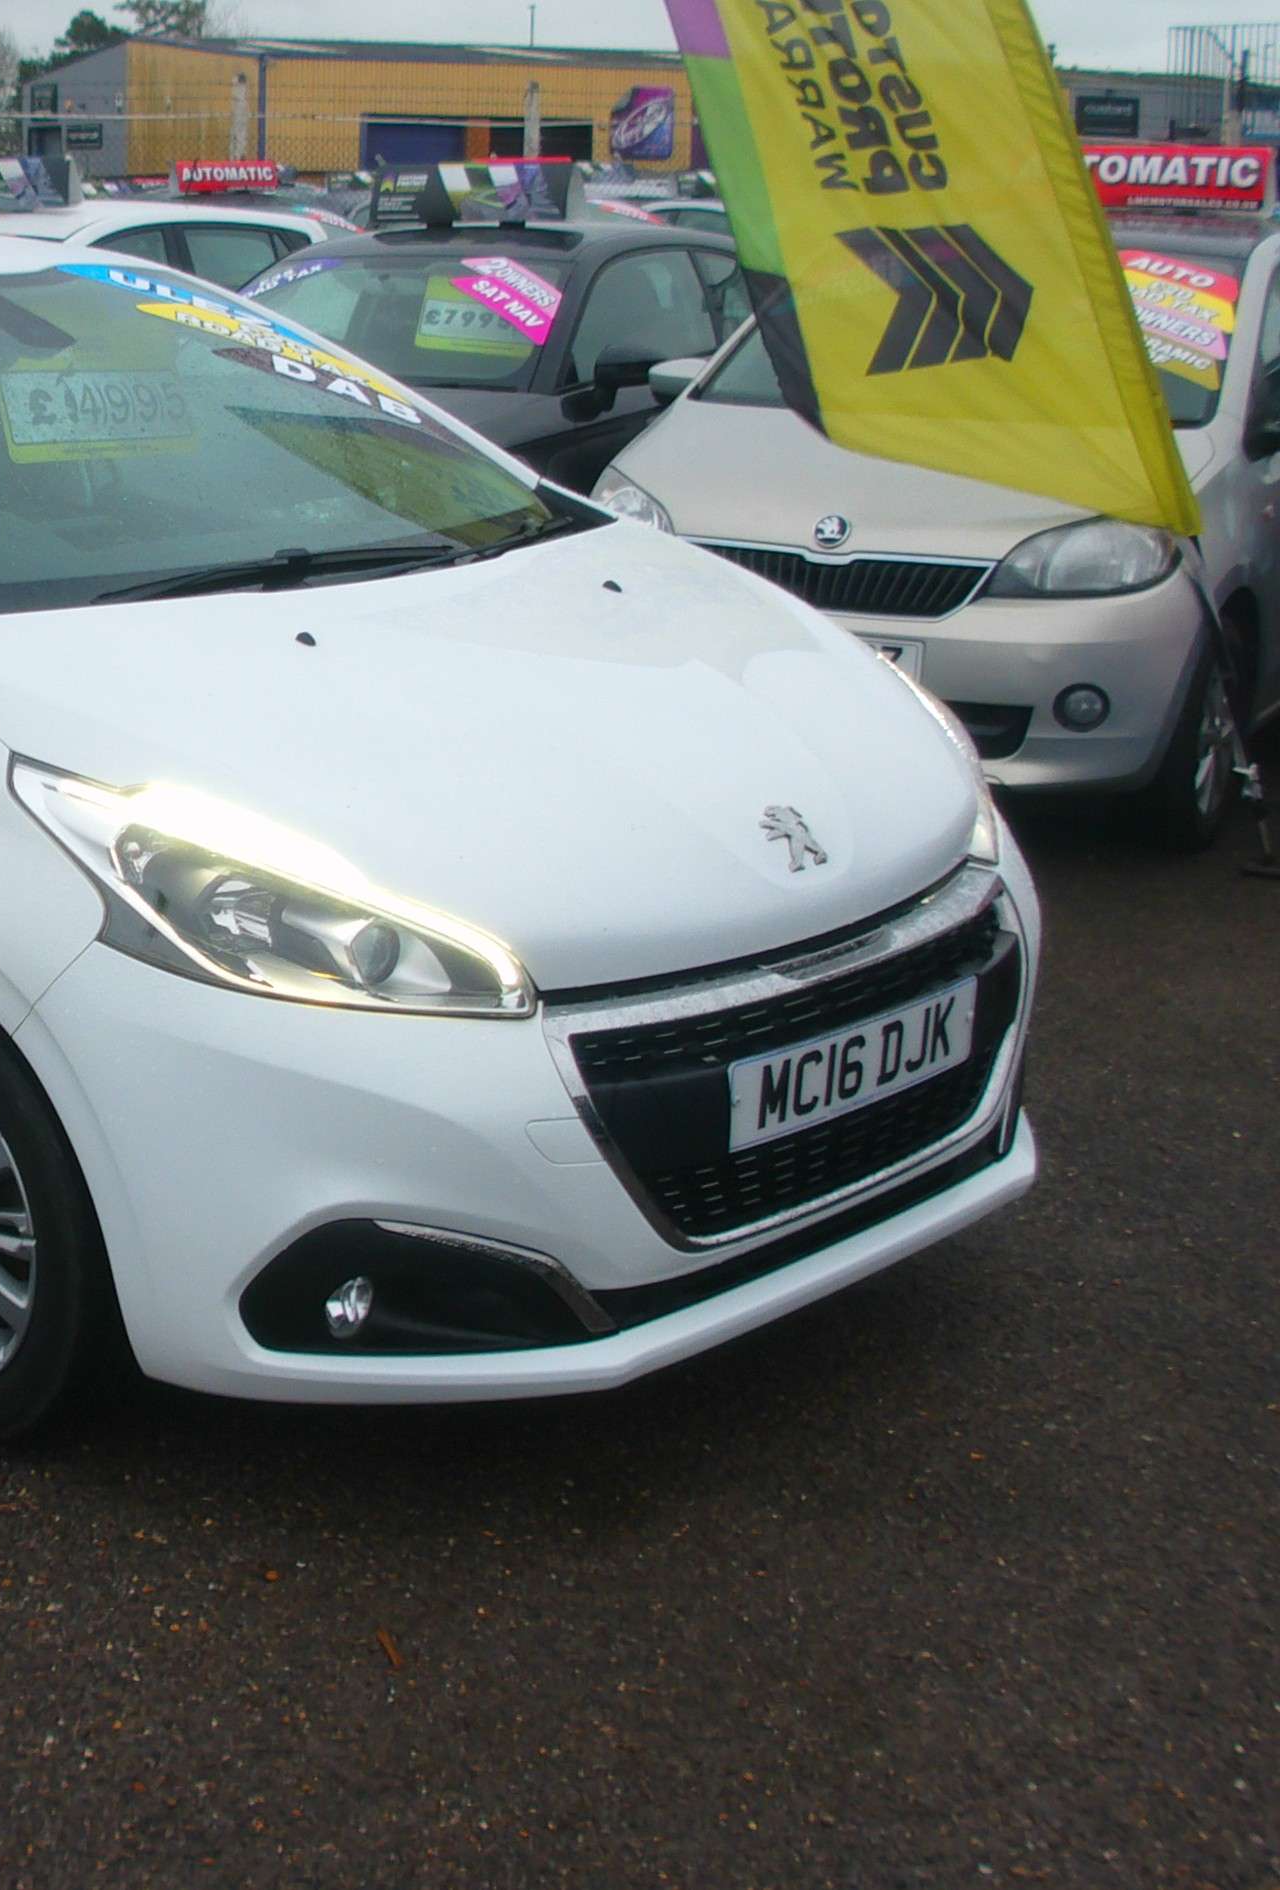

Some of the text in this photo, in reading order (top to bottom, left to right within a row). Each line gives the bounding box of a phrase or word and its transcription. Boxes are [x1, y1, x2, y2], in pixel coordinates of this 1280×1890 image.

[182, 166, 273, 182] AUTOMATIC
[497, 268, 556, 309] OWNERS
[1126, 256, 1217, 289] AUTO
[472, 280, 546, 328] SAT NAV
[272, 354, 421, 424] DAB
[757, 996, 956, 1130] MC16 DJK
